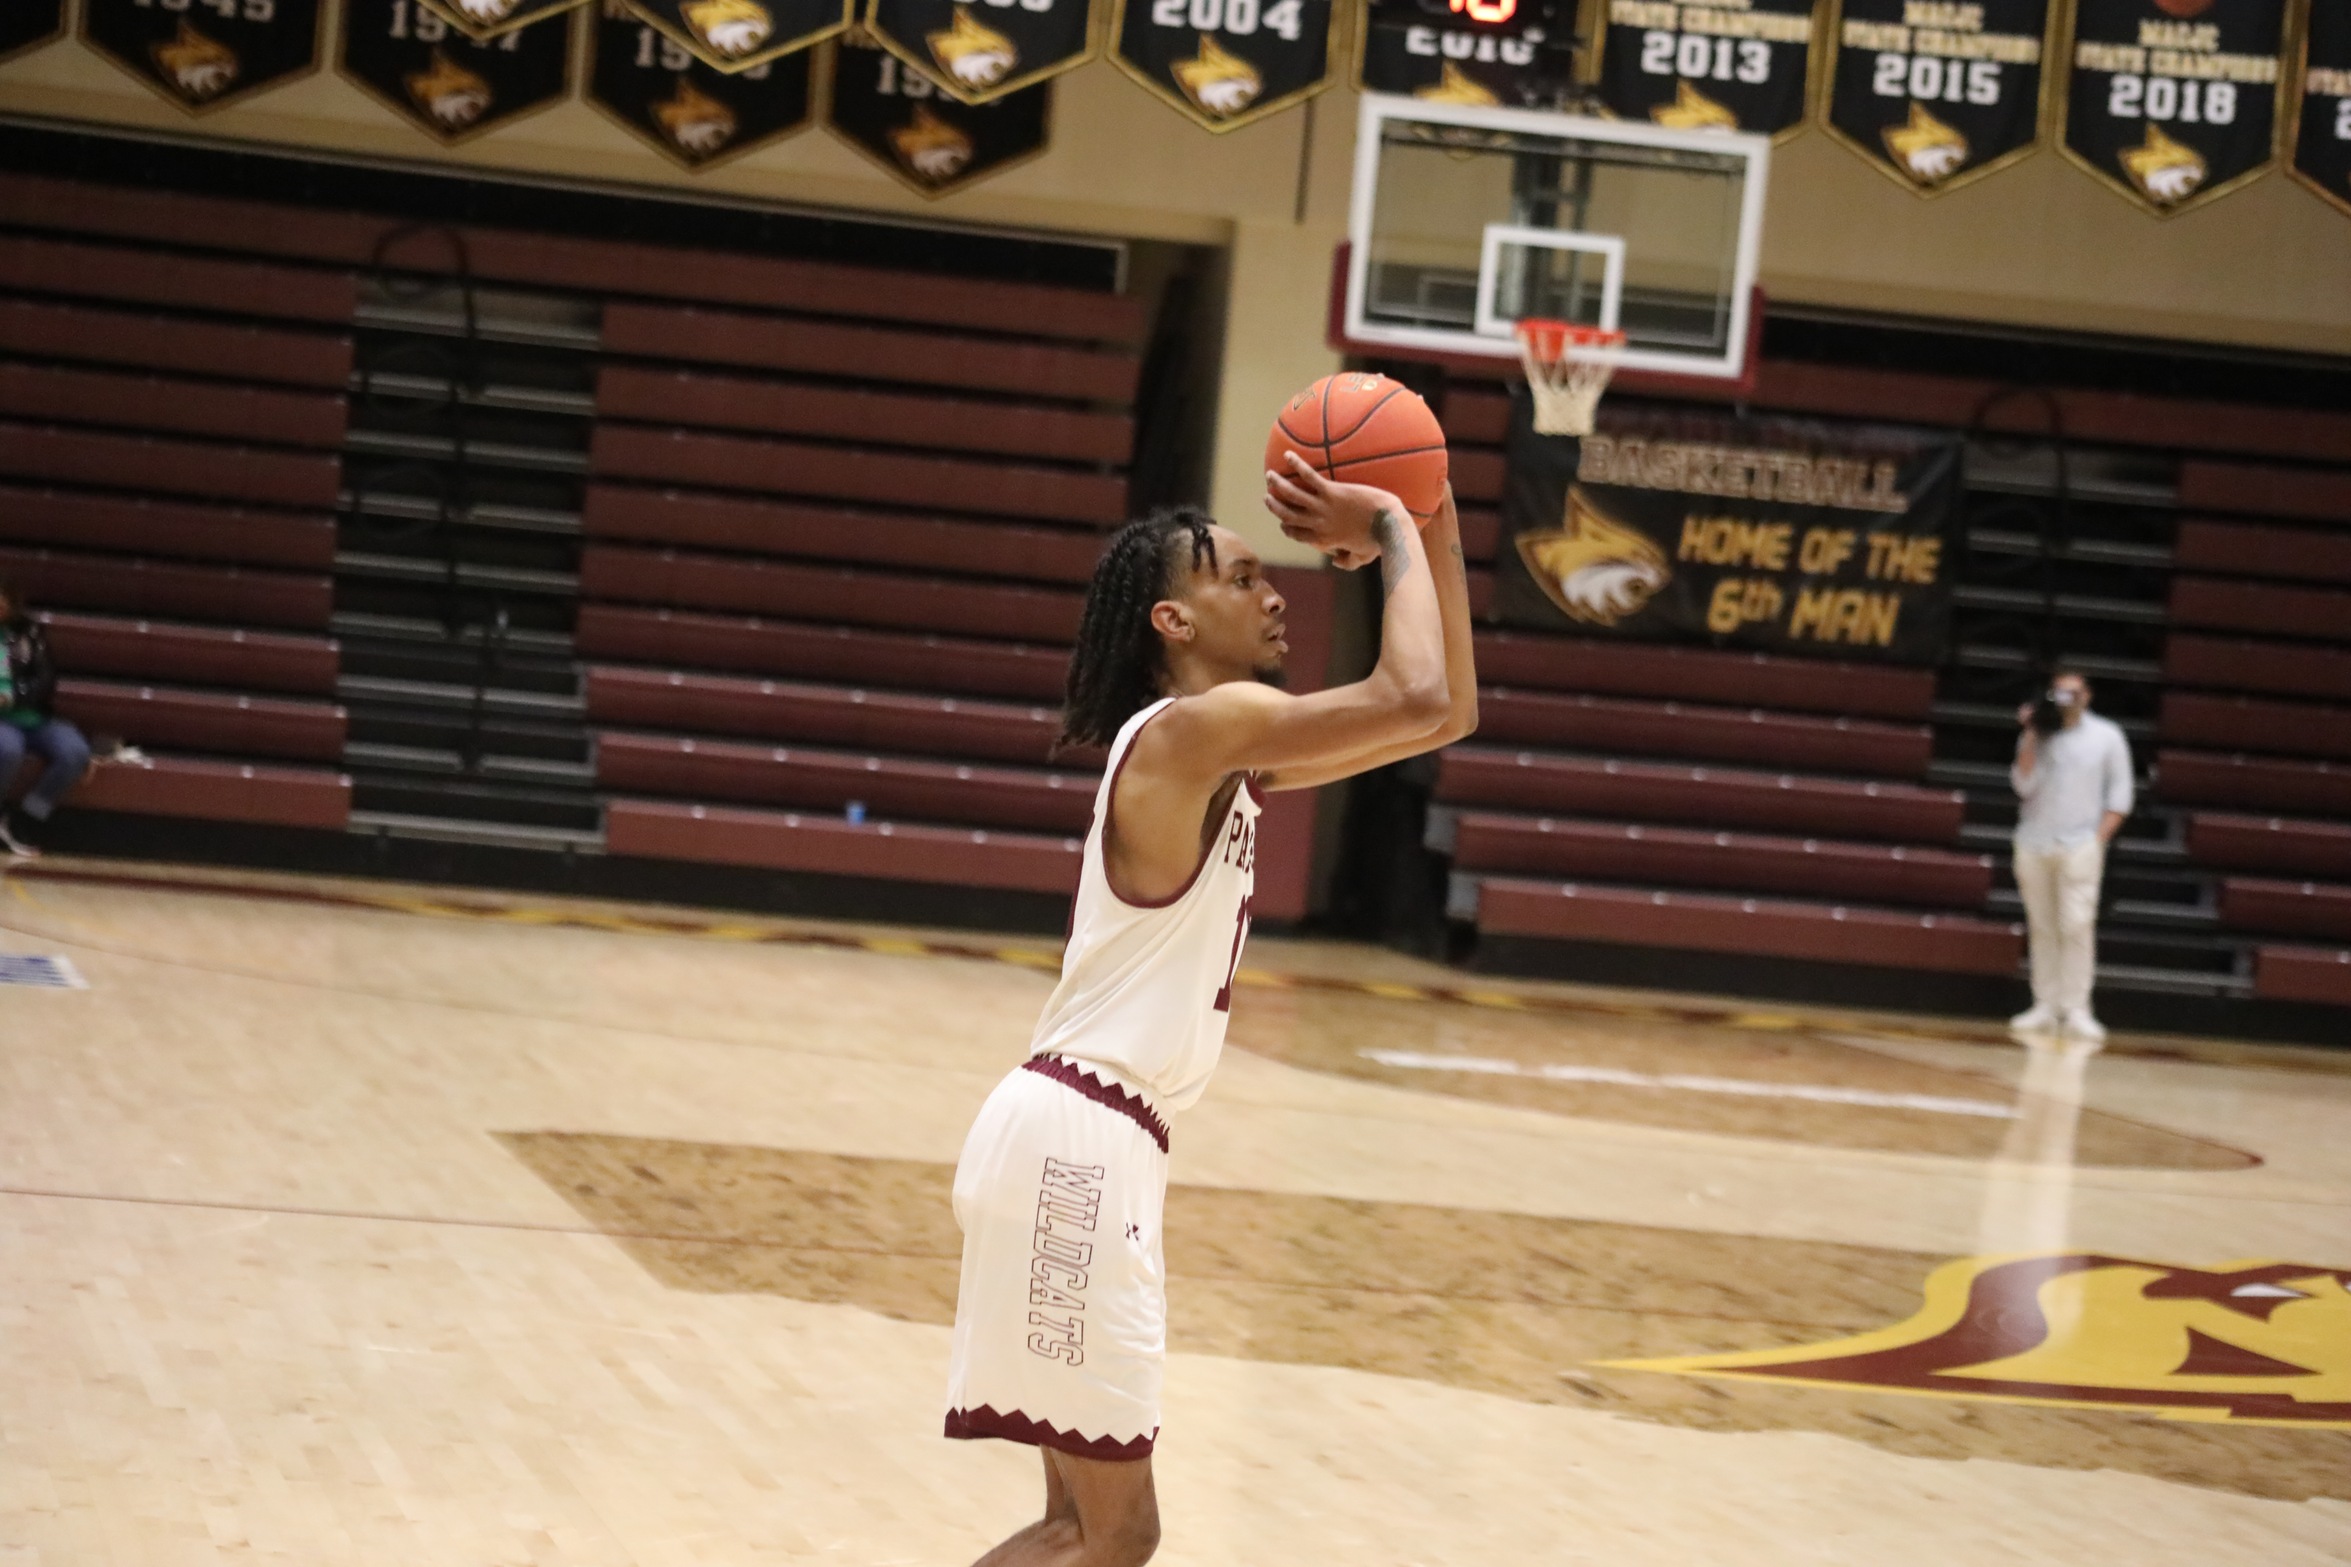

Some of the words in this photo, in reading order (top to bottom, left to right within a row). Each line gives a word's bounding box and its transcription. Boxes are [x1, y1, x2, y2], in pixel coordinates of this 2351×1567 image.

[1152, 0, 1302, 41] 2004
[1641, 30, 1772, 84] 2013
[1873, 53, 2001, 105] 2015
[2108, 74, 2237, 125] 2018
[1577, 433, 1909, 513] BASKETBALL
[1678, 515, 1793, 571] HOME
[1799, 526, 1856, 575] OF
[1866, 532, 1942, 585] THE
[1788, 587, 1900, 646] MAN
[1027, 1156, 1105, 1366] WILDCATS
